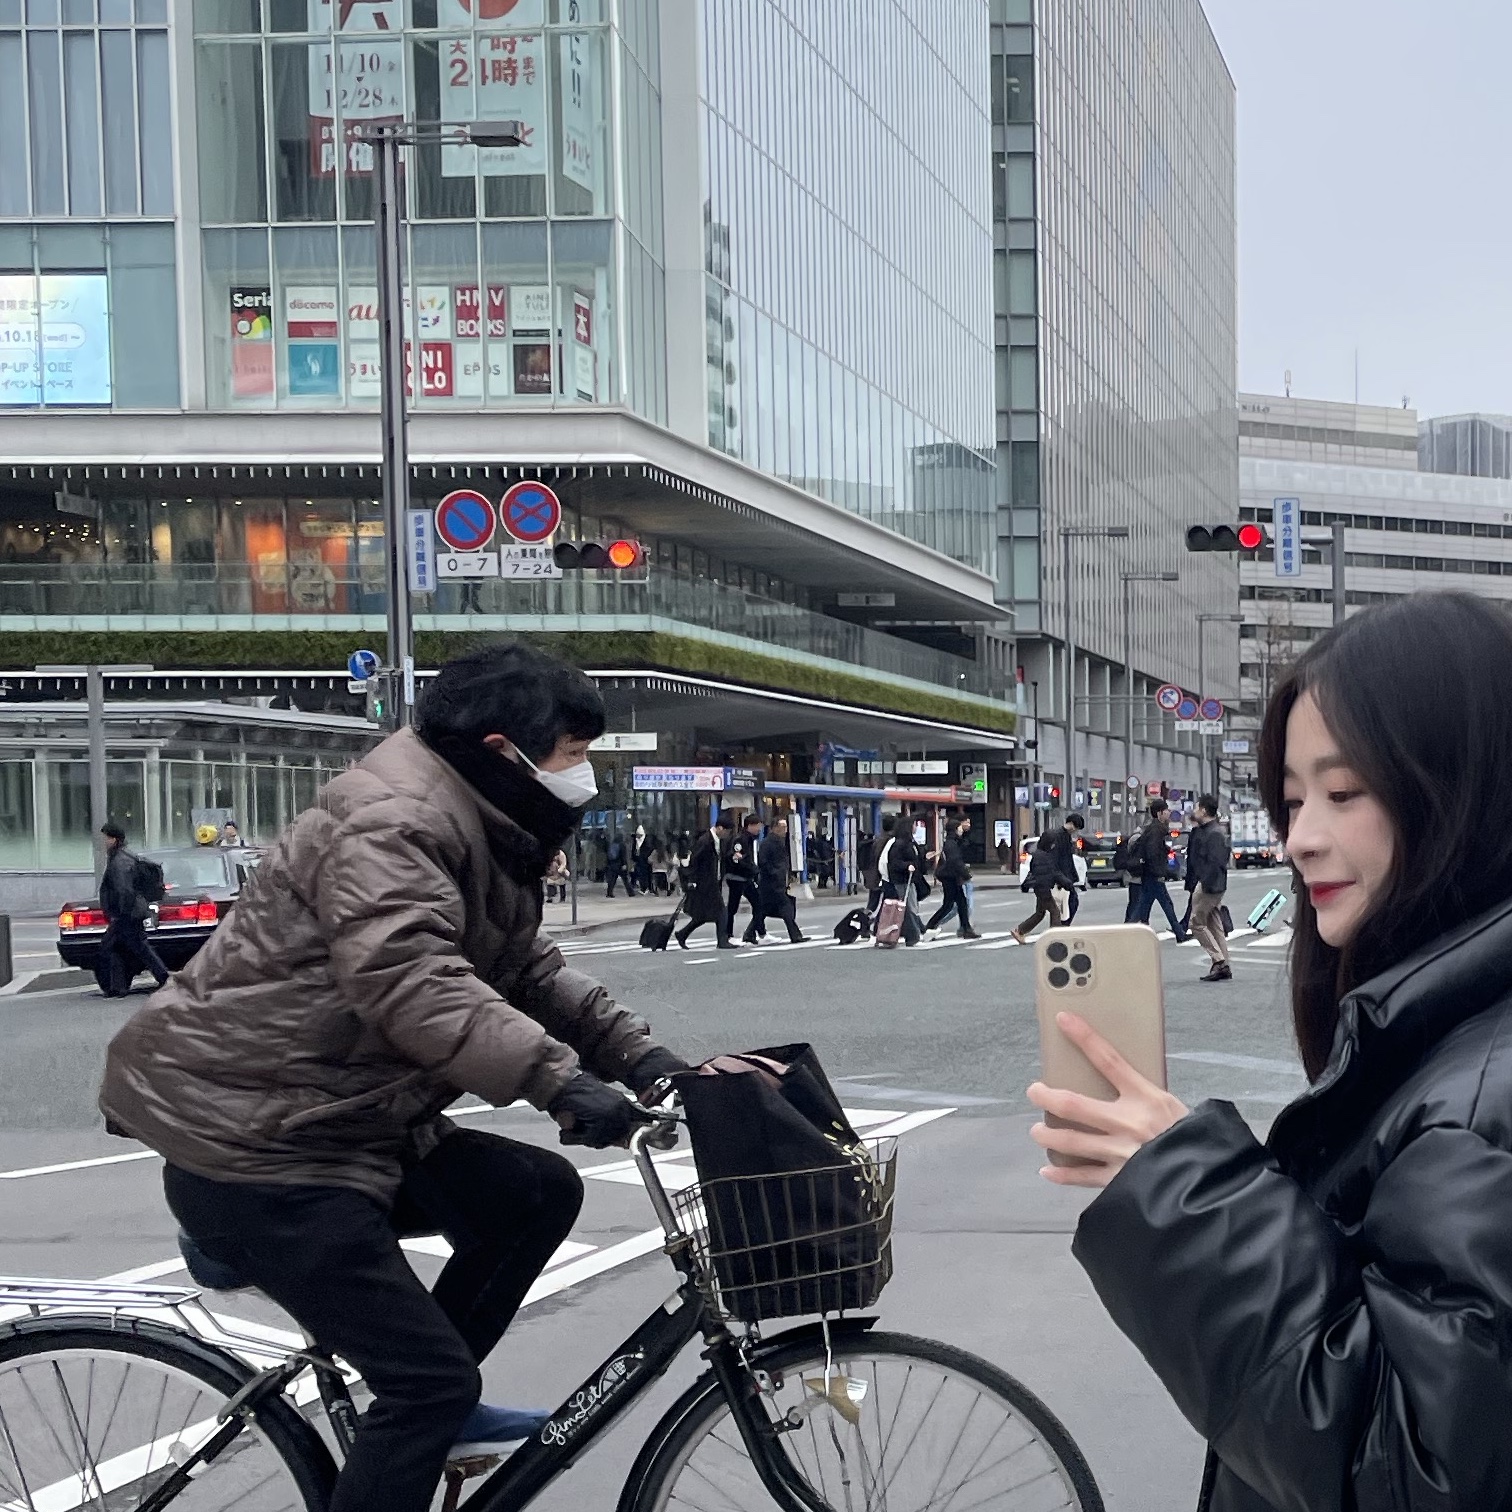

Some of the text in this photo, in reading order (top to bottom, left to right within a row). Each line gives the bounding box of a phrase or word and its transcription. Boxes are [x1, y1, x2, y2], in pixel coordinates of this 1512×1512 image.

[289, 299, 335, 310] docomo
[457, 320, 505, 335] BOKS
[447, 557, 488, 572] 0-7
[511, 563, 553, 576] 7-24
